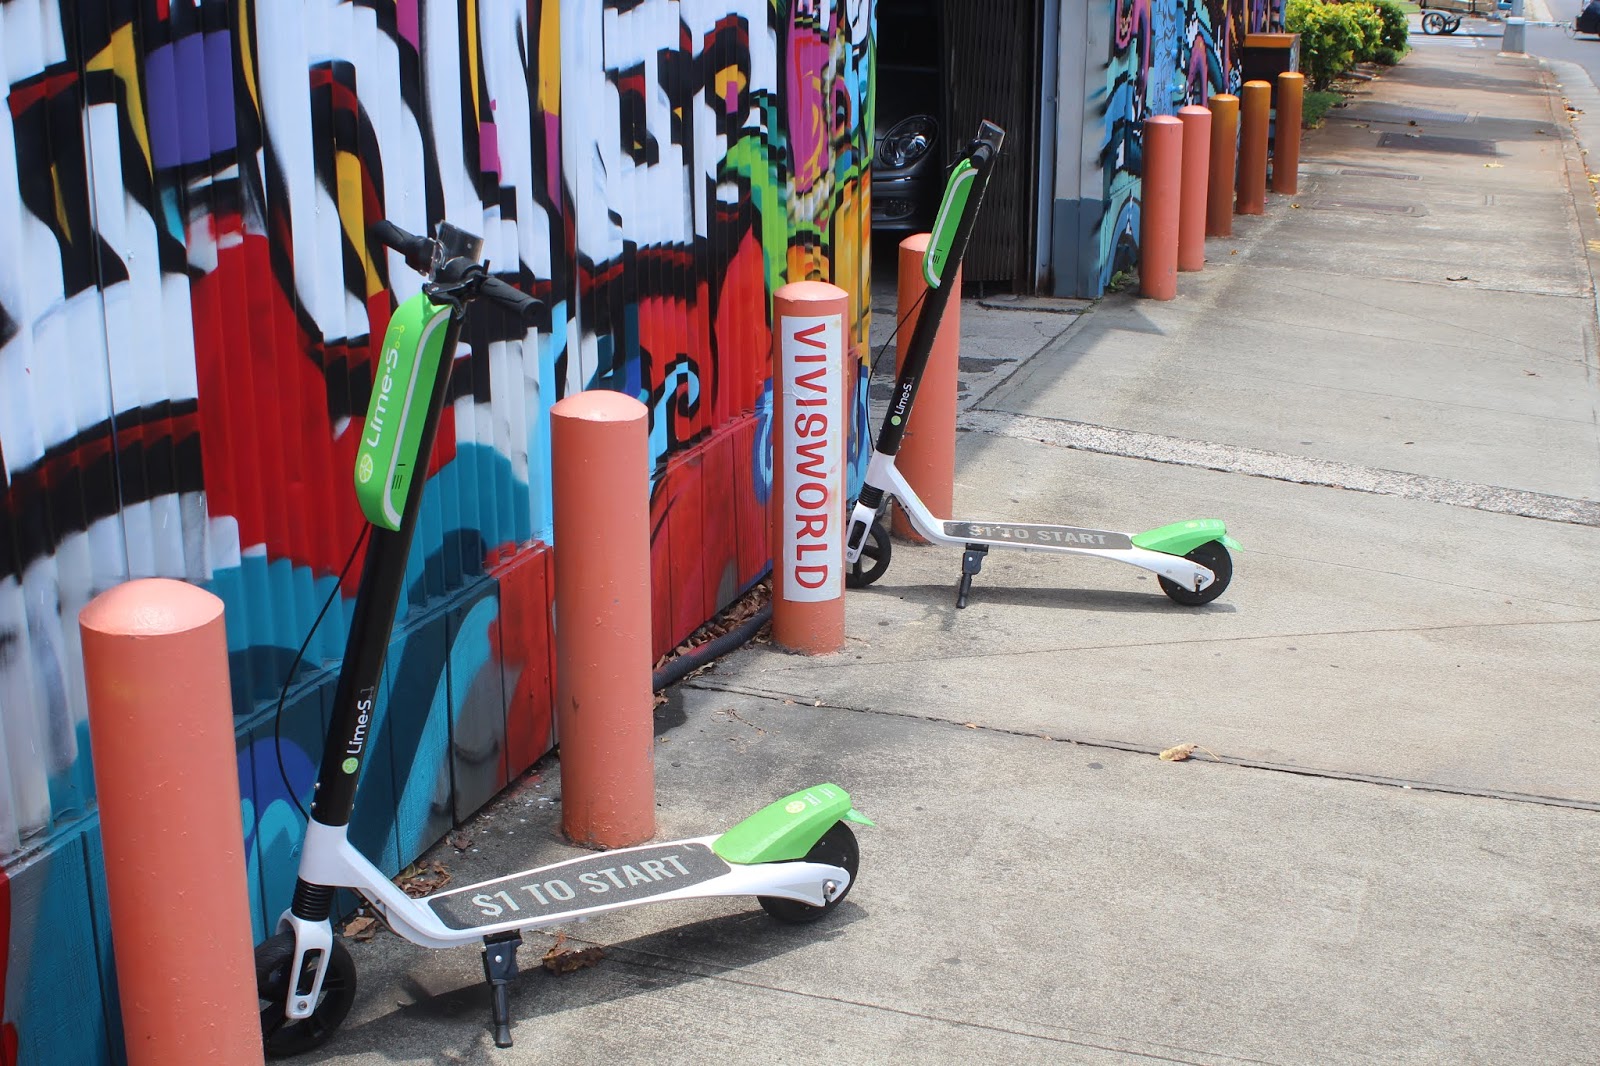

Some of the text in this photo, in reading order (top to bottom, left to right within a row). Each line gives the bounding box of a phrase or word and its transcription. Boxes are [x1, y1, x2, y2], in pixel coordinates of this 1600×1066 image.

[793, 322, 828, 589] VIVISWORLD
[998, 527, 1030, 539] TO
[1037, 530, 1106, 545] START
[471, 855, 690, 917] $1 TO START
